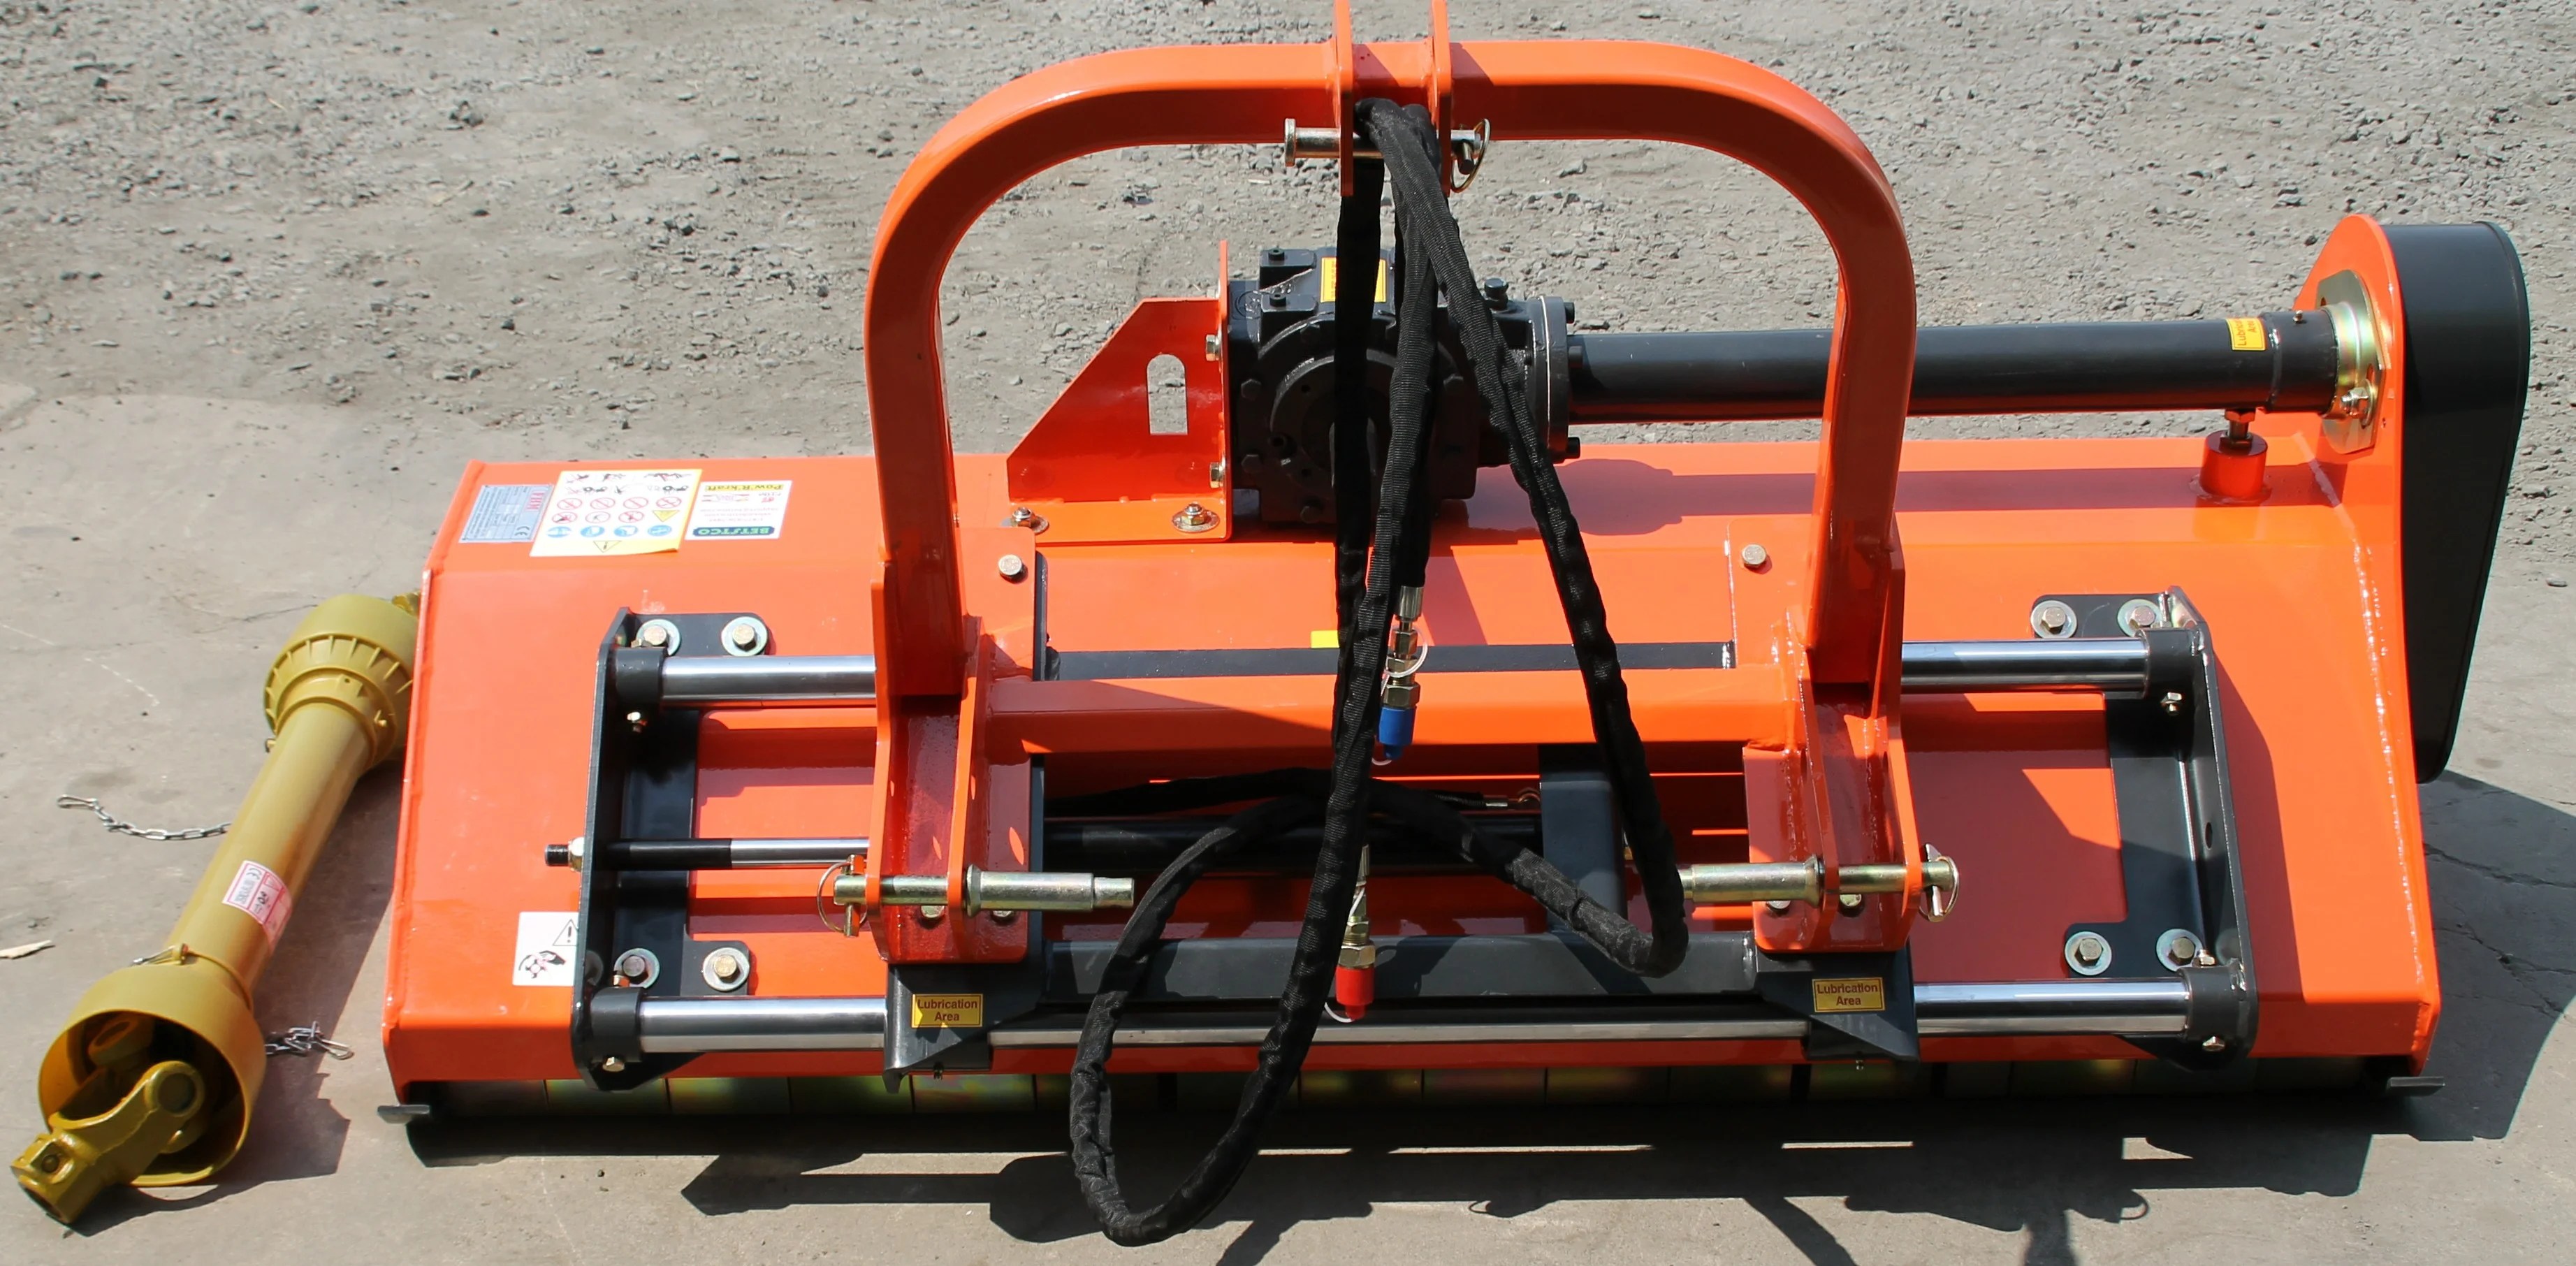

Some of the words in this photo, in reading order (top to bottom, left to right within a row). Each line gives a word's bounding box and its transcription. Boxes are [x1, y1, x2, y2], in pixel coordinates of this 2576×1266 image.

[1817, 982, 1878, 994] Lubrication
[917, 999, 977, 1009] Lubrication
[1836, 996, 1861, 1005] Area
[934, 1012, 960, 1021] Area
